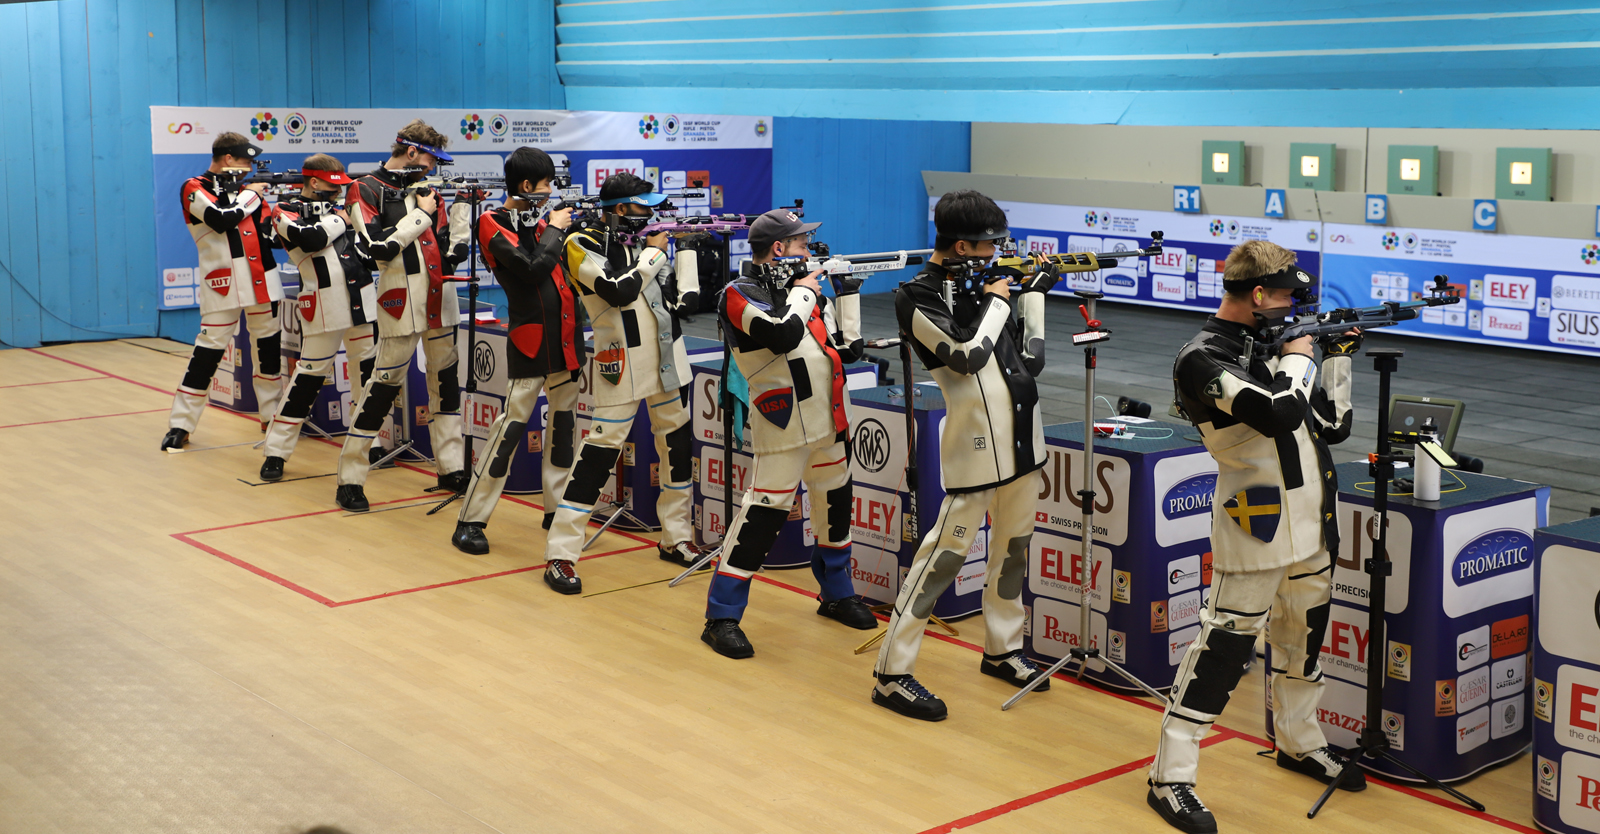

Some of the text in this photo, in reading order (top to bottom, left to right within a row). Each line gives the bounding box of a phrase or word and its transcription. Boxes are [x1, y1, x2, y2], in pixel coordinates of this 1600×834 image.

[1174, 189, 1200, 209] R1
[1266, 192, 1283, 214] A
[1366, 198, 1385, 220] B
[1474, 202, 1496, 226] C
[1155, 252, 1182, 267] ELEY
[212, 278, 229, 287] AUT
[1157, 282, 1181, 294] Perazzi
[1490, 282, 1529, 299] ELEY
[1566, 288, 1600, 299] BERETT
[300, 300, 311, 308] RB
[383, 299, 403, 308] NOR
[1488, 316, 1522, 331] Perazzi
[1557, 312, 1599, 336] SIUS
[599, 362, 619, 373] IND
[760, 399, 788, 413] USA
[859, 426, 884, 467] RWS
[1170, 492, 1214, 514] PROMA
[1050, 516, 1108, 536] SWISS PRSION
[872, 532, 895, 544] champions
[1460, 546, 1527, 578] PROMATIC
[1050, 581, 1067, 591] choice
[1074, 588, 1101, 600] chions
[1336, 582, 1371, 599] PRECISI
[1171, 606, 1198, 622] GUERINI
[1336, 658, 1369, 674] champion
[1460, 683, 1487, 704] GUERINI
[1569, 728, 1584, 740] the
